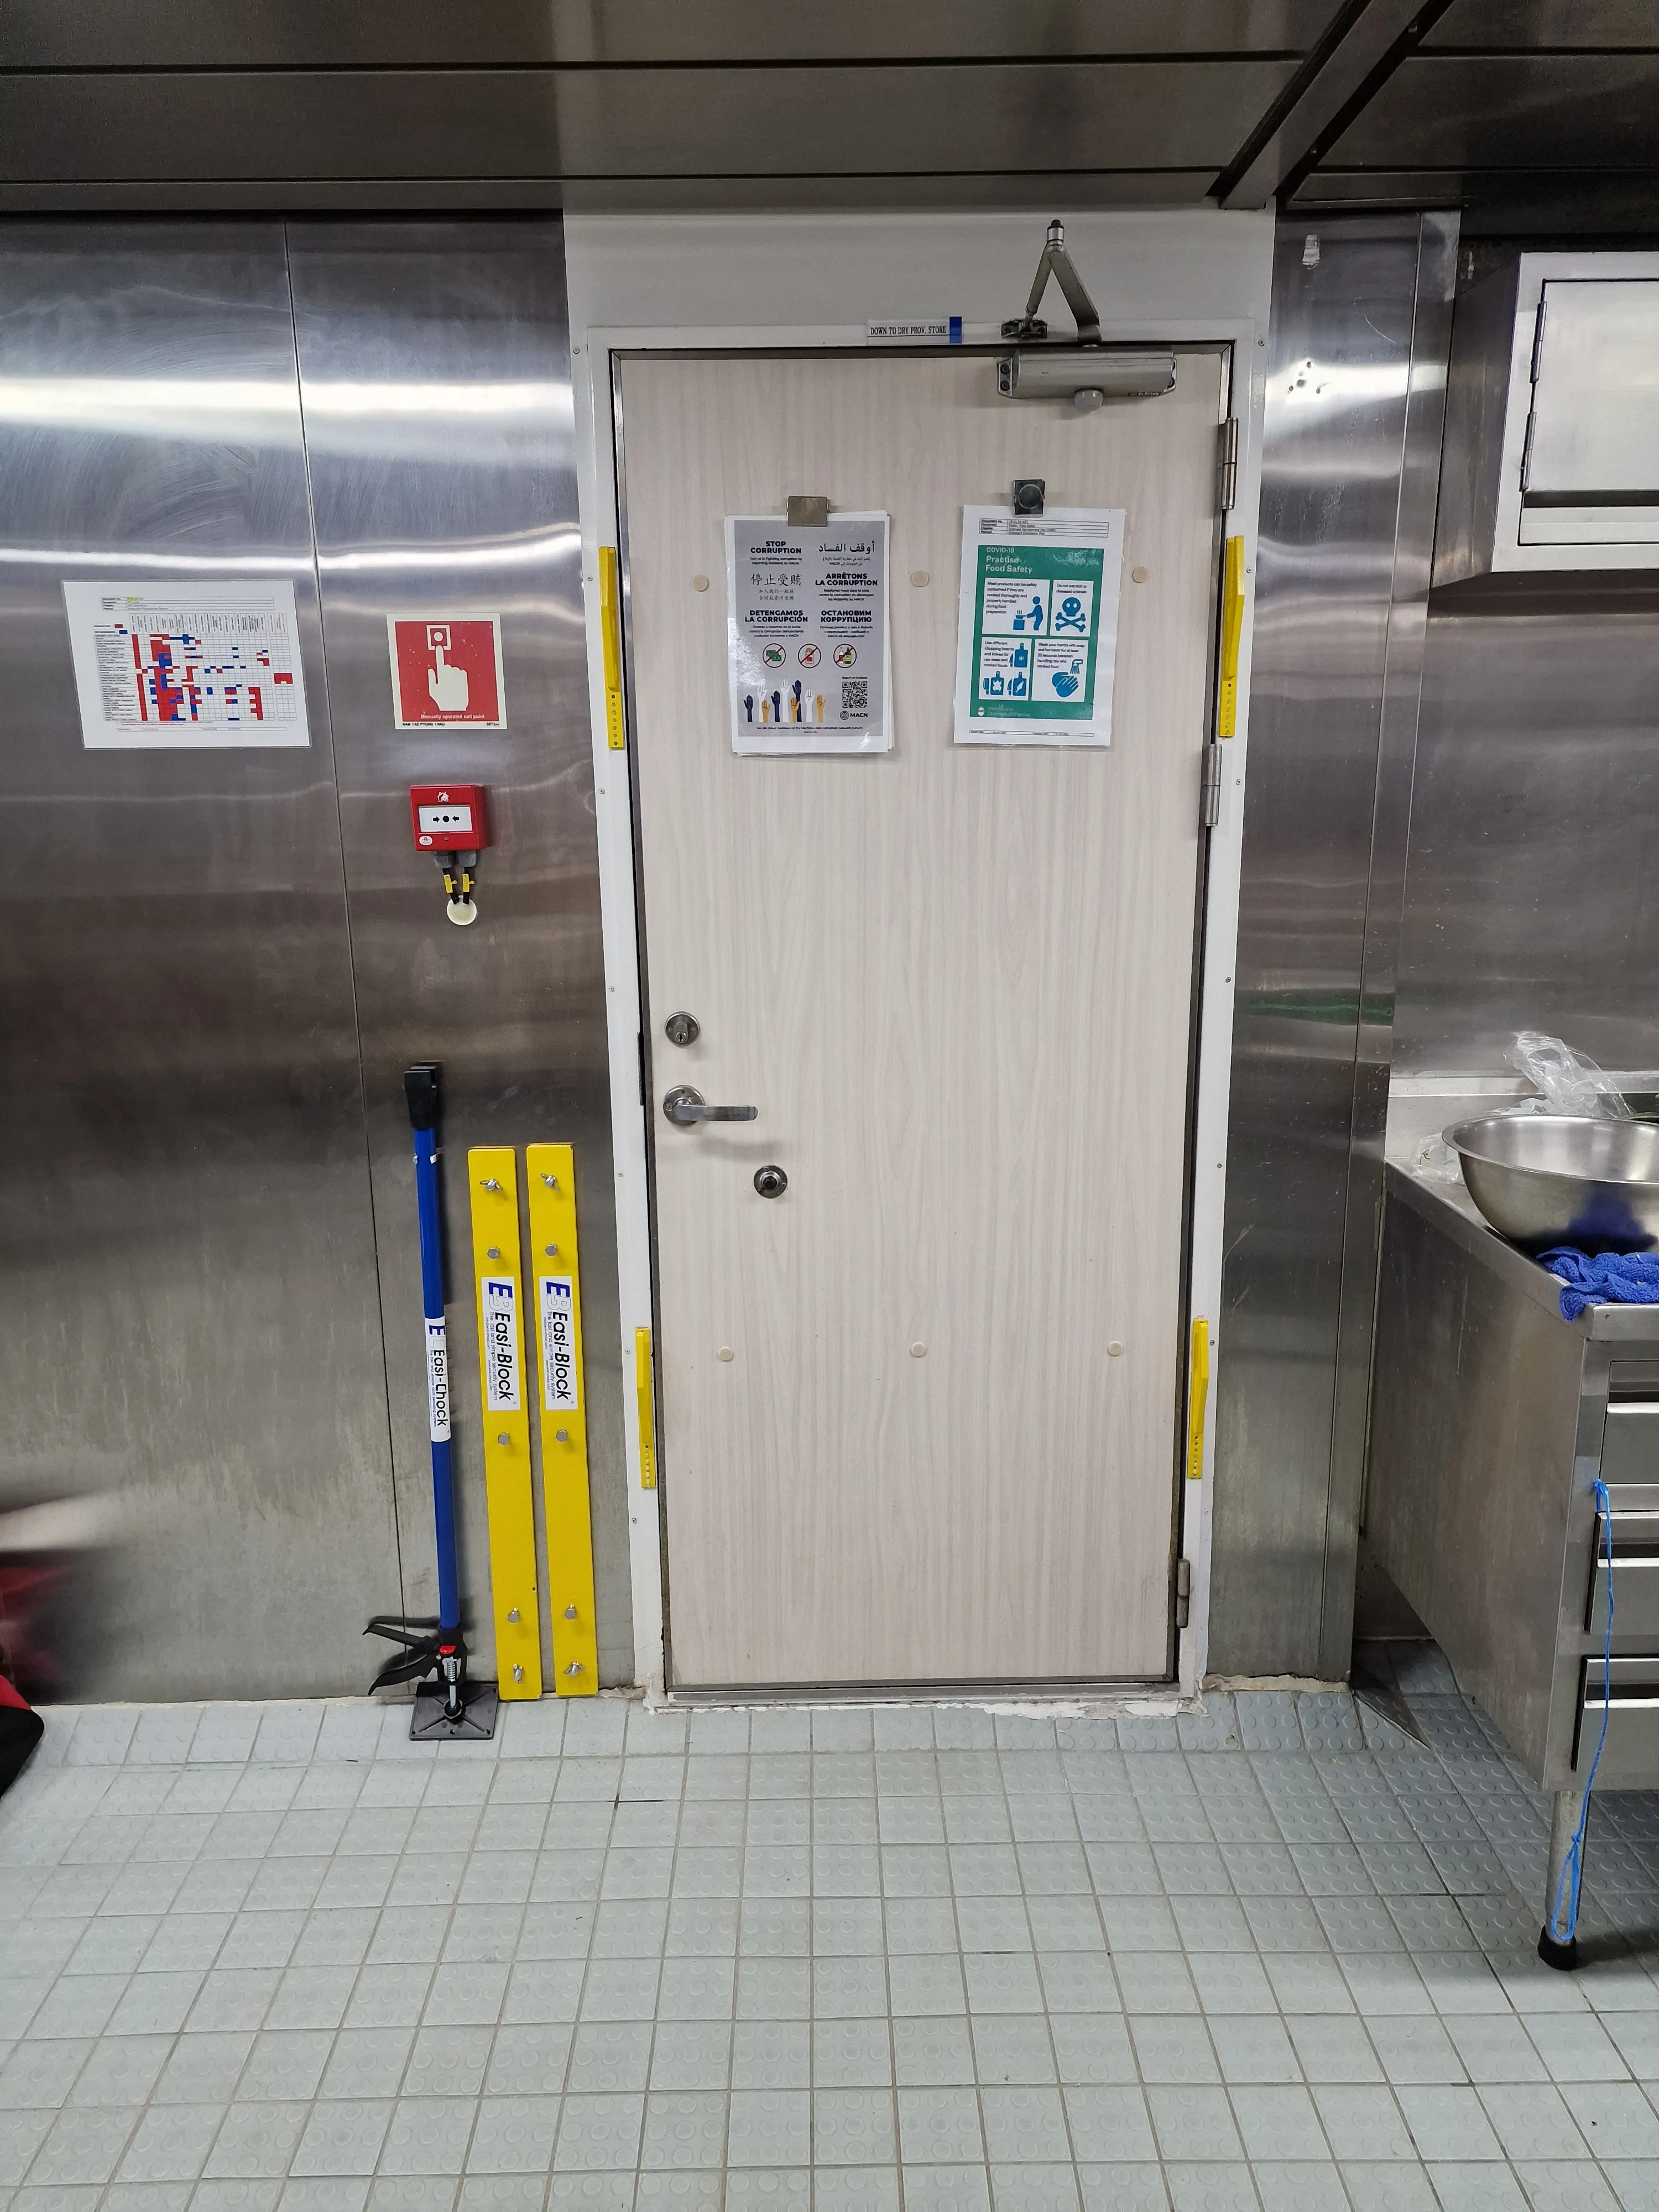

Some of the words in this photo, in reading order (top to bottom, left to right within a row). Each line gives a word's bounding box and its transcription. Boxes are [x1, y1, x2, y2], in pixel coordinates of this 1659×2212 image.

[870, 327, 887, 335] DOWN
[898, 326, 909, 335] DRY
[910, 326, 927, 334] PROV.
[928, 325, 946, 333] STORE
[818, 542, 846, 552] الفساد
[849, 540, 875, 555] أوقف
[1006, 565, 1032, 575] Safety
[750, 573, 802, 586] 停止受贿
[495, 1312, 514, 1401] Easi-Block
[552, 1312, 571, 1400] Easi-Block
[434, 1350, 448, 1427] Easi-Chock
